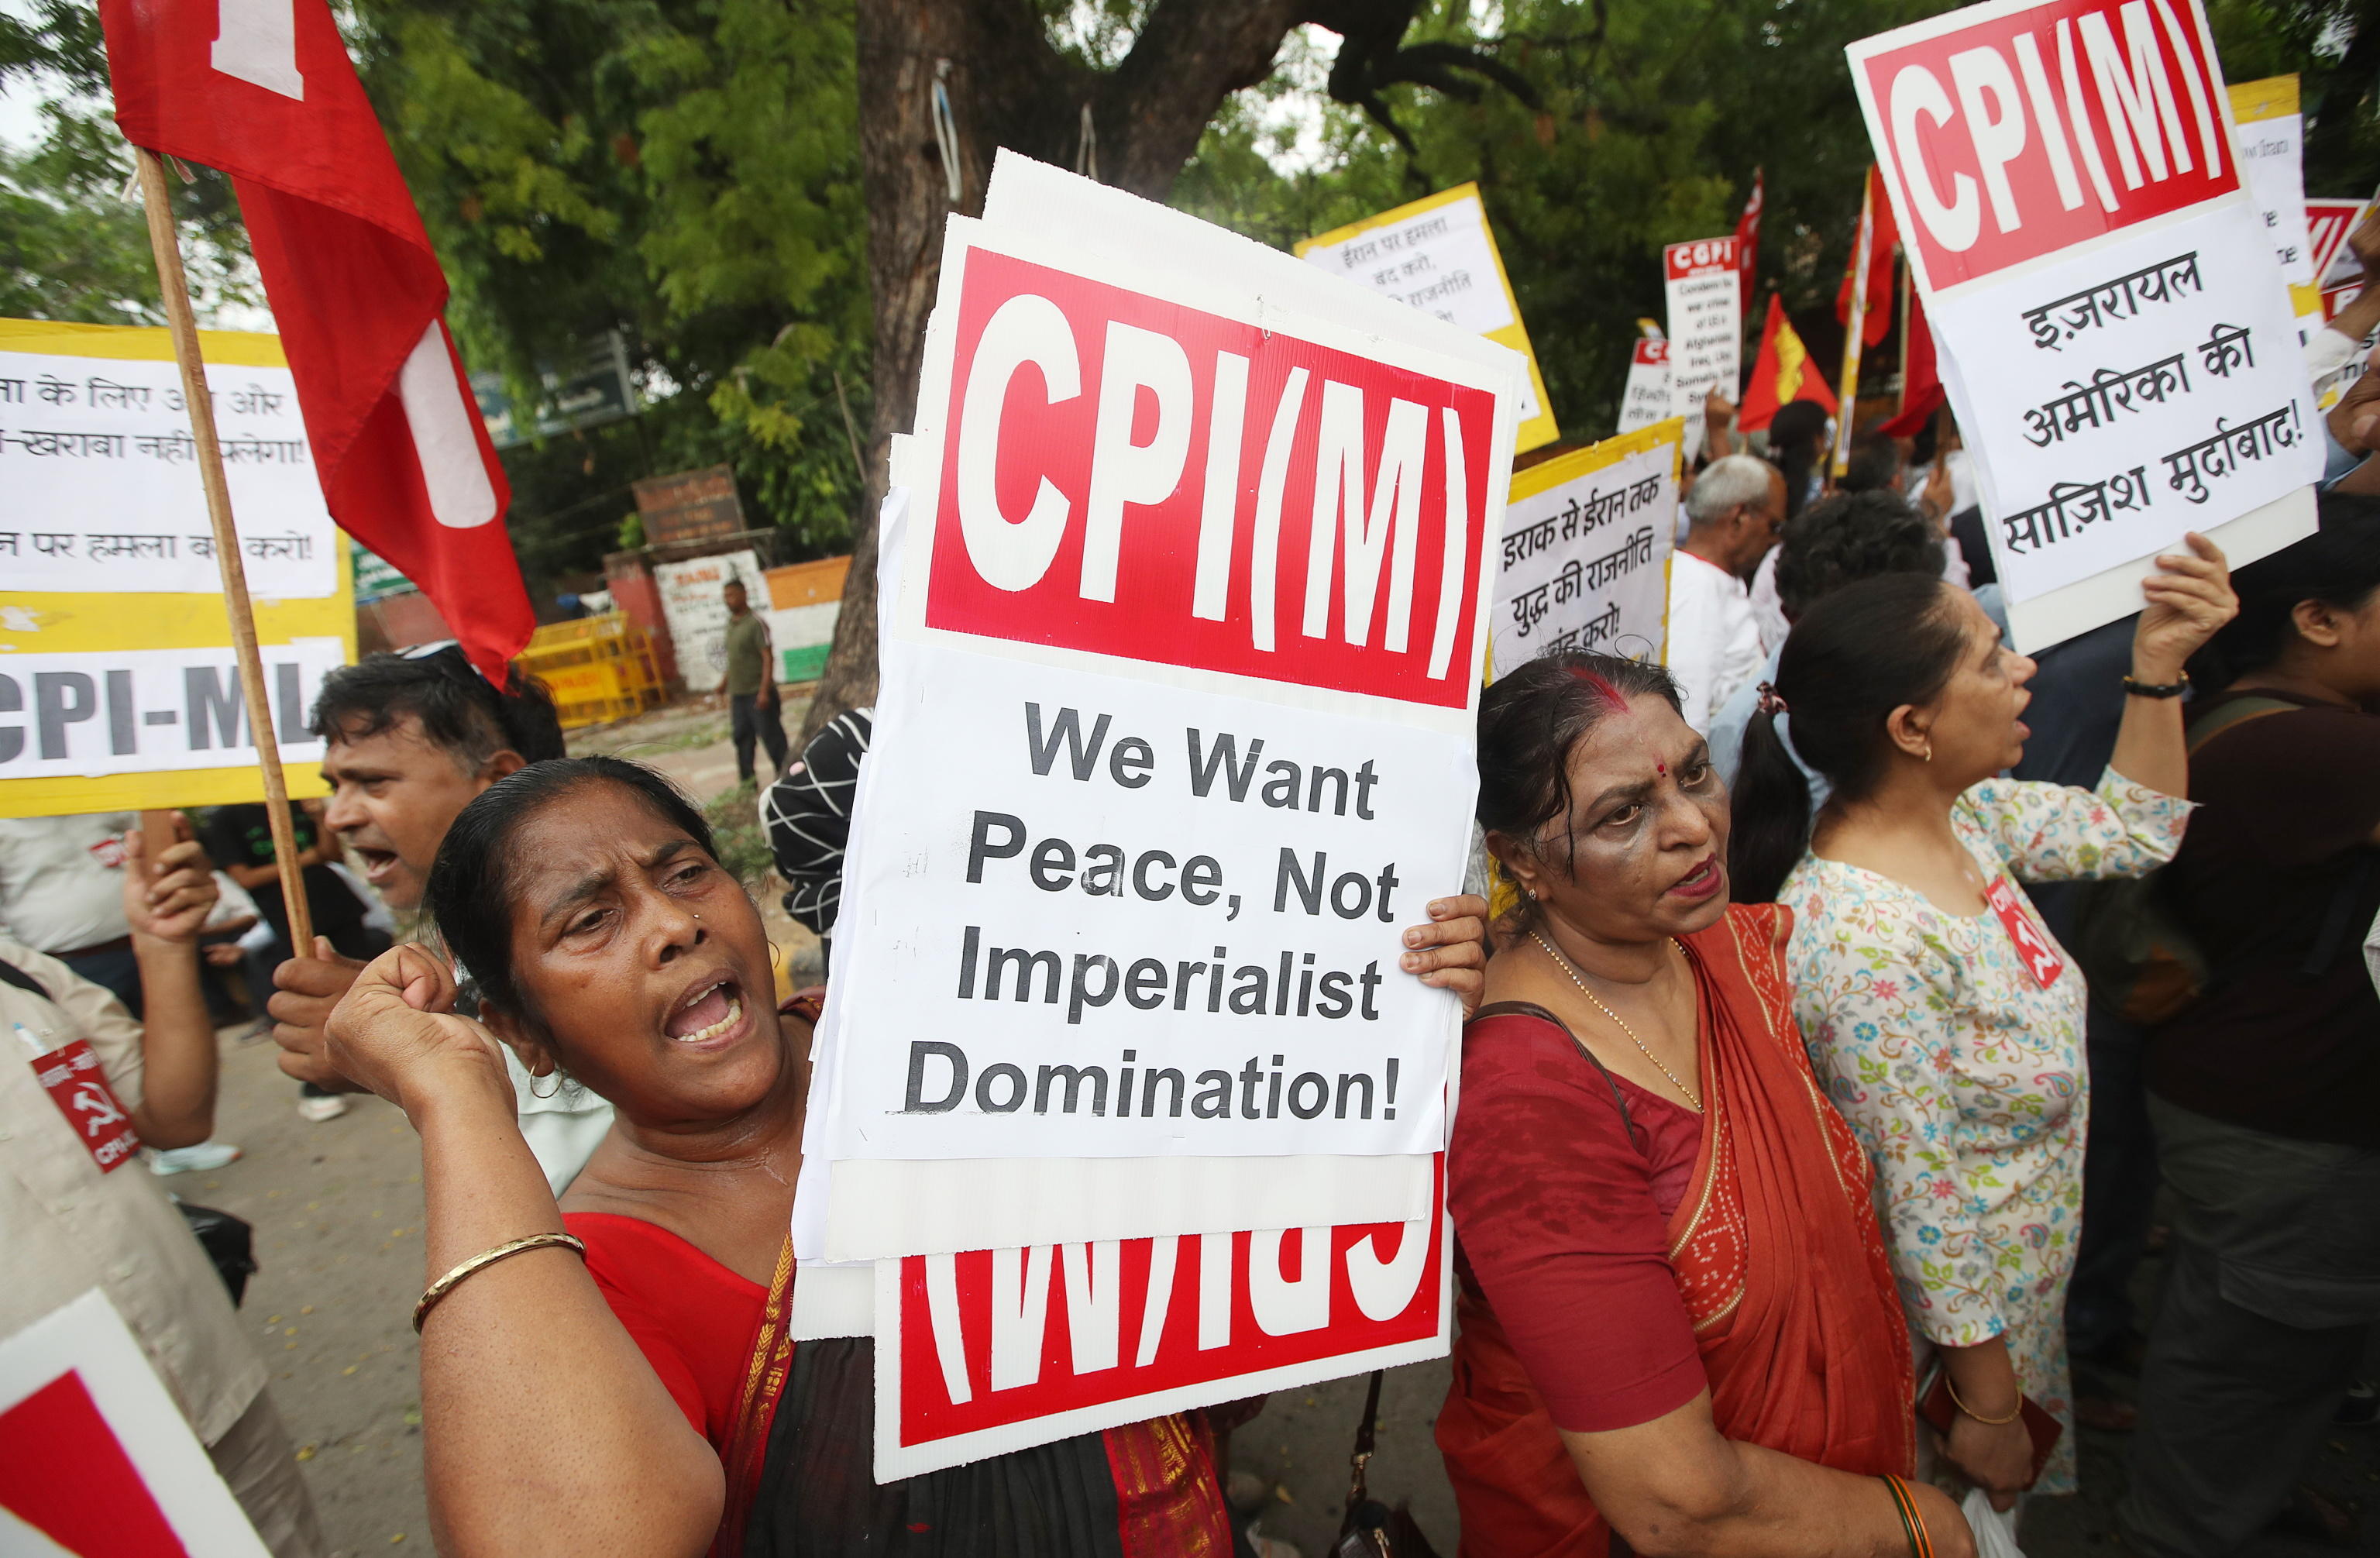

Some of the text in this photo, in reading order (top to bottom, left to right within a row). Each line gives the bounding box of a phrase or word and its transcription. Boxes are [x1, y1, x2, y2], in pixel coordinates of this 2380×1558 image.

[1890, 0, 2222, 253] CPI(M)
[1380, 233, 1401, 250] पर
[1404, 217, 1448, 246] हमला
[1673, 241, 1732, 269] CGPI
[2021, 250, 2203, 351] इज़रायल
[36, 373, 77, 406] के
[88, 377, 153, 411] लिए
[227, 383, 284, 416] और
[2023, 323, 2254, 448] अमेरिका की
[958, 294, 1467, 680] CPI(M)
[1502, 473, 1661, 572] इराक से ईरान तक
[2003, 399, 2304, 555] साज़िश मुर्दाबाद!
[31, 533, 76, 558] पर
[85, 535, 177, 563] हमला
[246, 530, 312, 560] करो!
[1512, 525, 1655, 638] युद्ध की राजनीति
[1584, 602, 1620, 648] करो!
[1025, 701, 1379, 820] We Want
[965, 810, 1399, 923] Peace, Not
[958, 925, 1382, 1025] Imperialist
[904, 1040, 1399, 1121] Domination!
